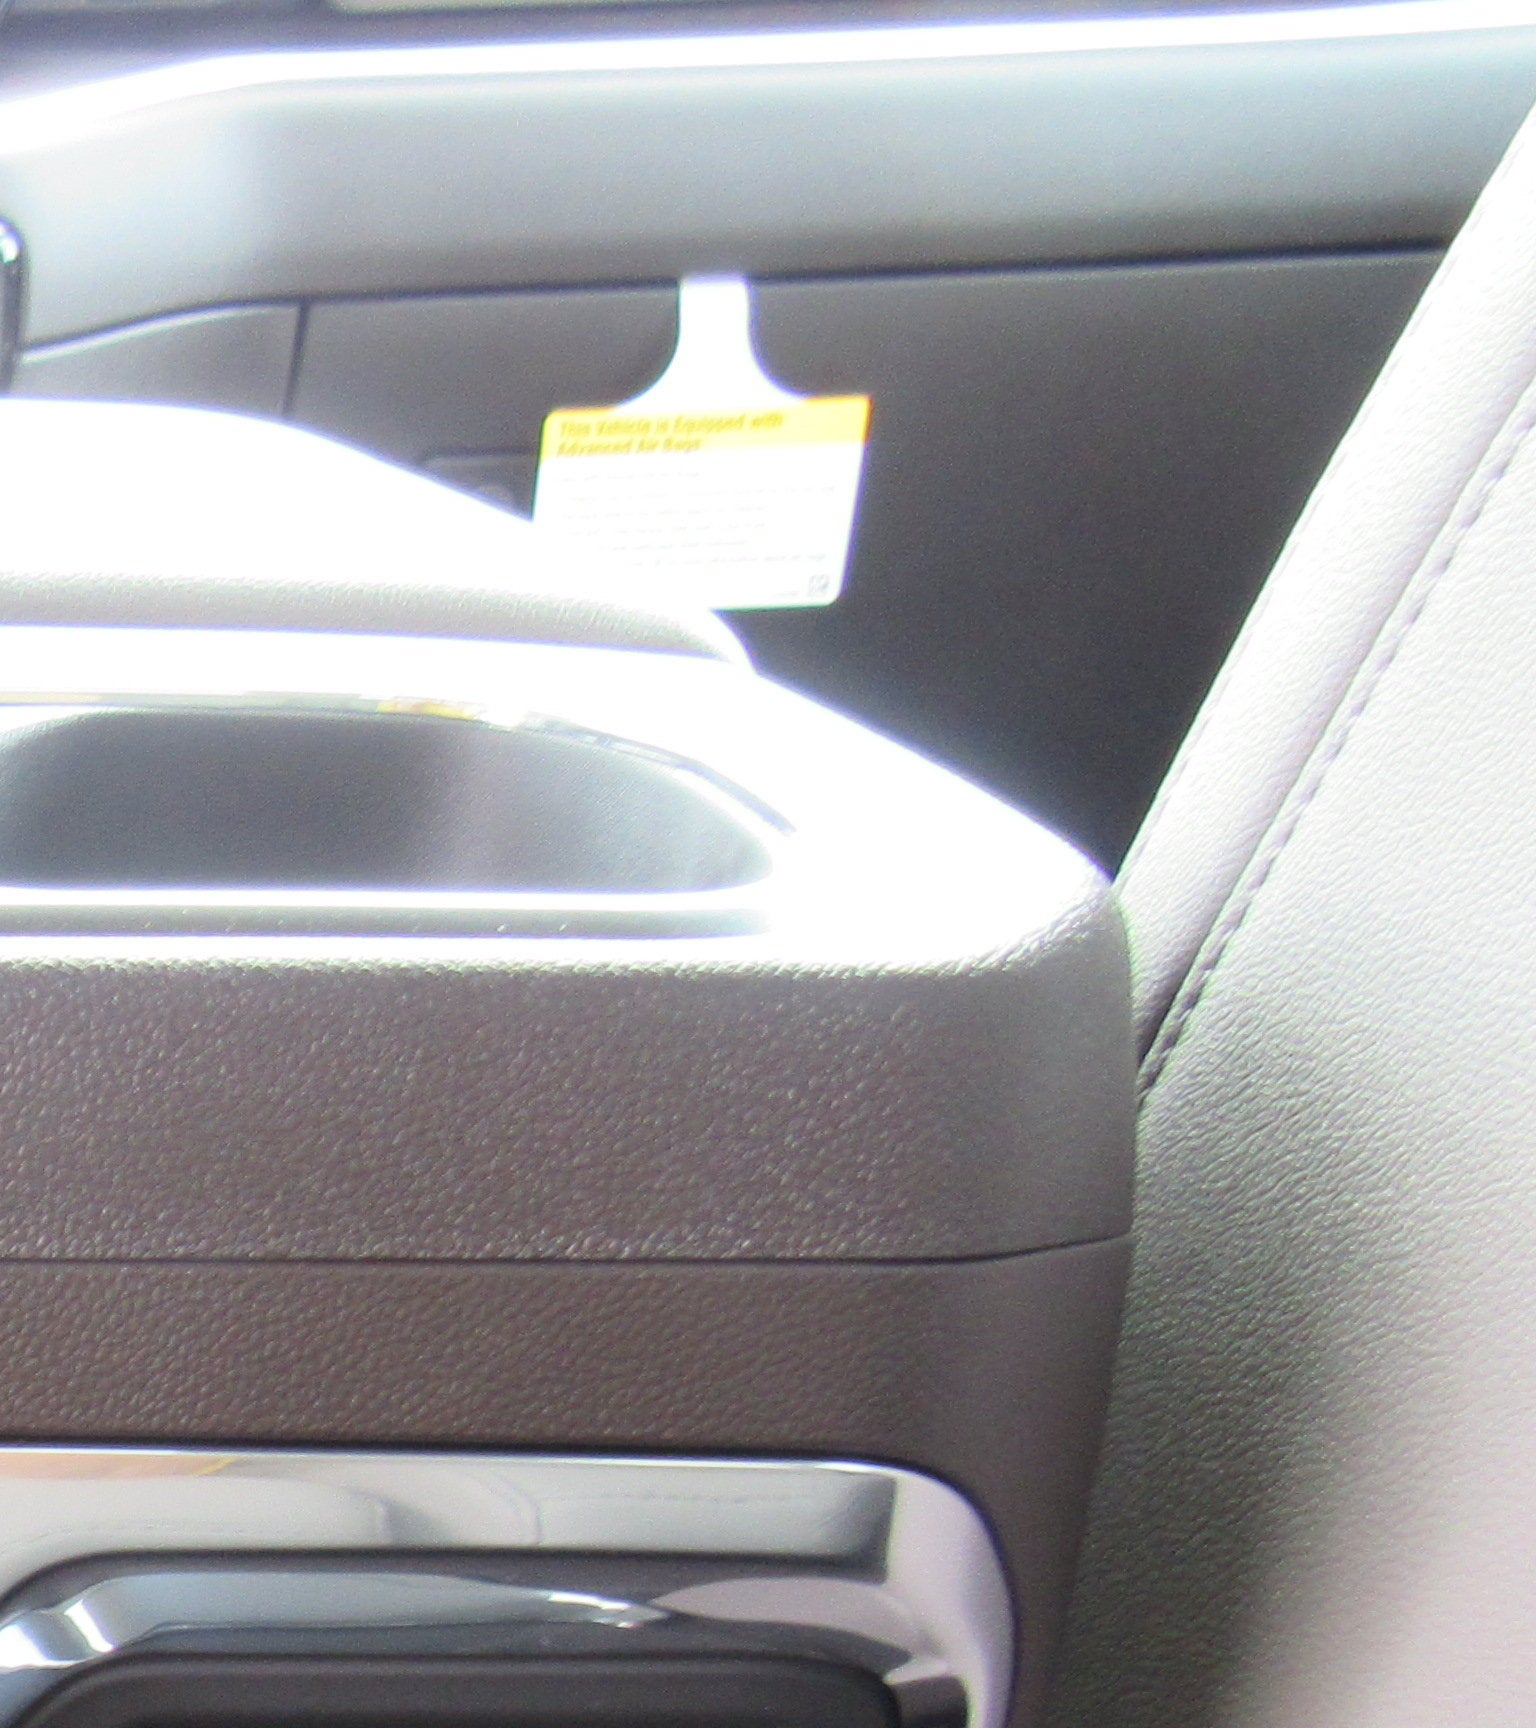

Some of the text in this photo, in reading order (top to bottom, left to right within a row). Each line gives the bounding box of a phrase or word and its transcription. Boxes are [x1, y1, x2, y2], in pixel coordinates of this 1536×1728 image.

[596, 417, 650, 436] Vehicle
[672, 413, 744, 436] Equipped
[750, 411, 784, 430] with
[557, 436, 703, 458] Advanced Air Bags
